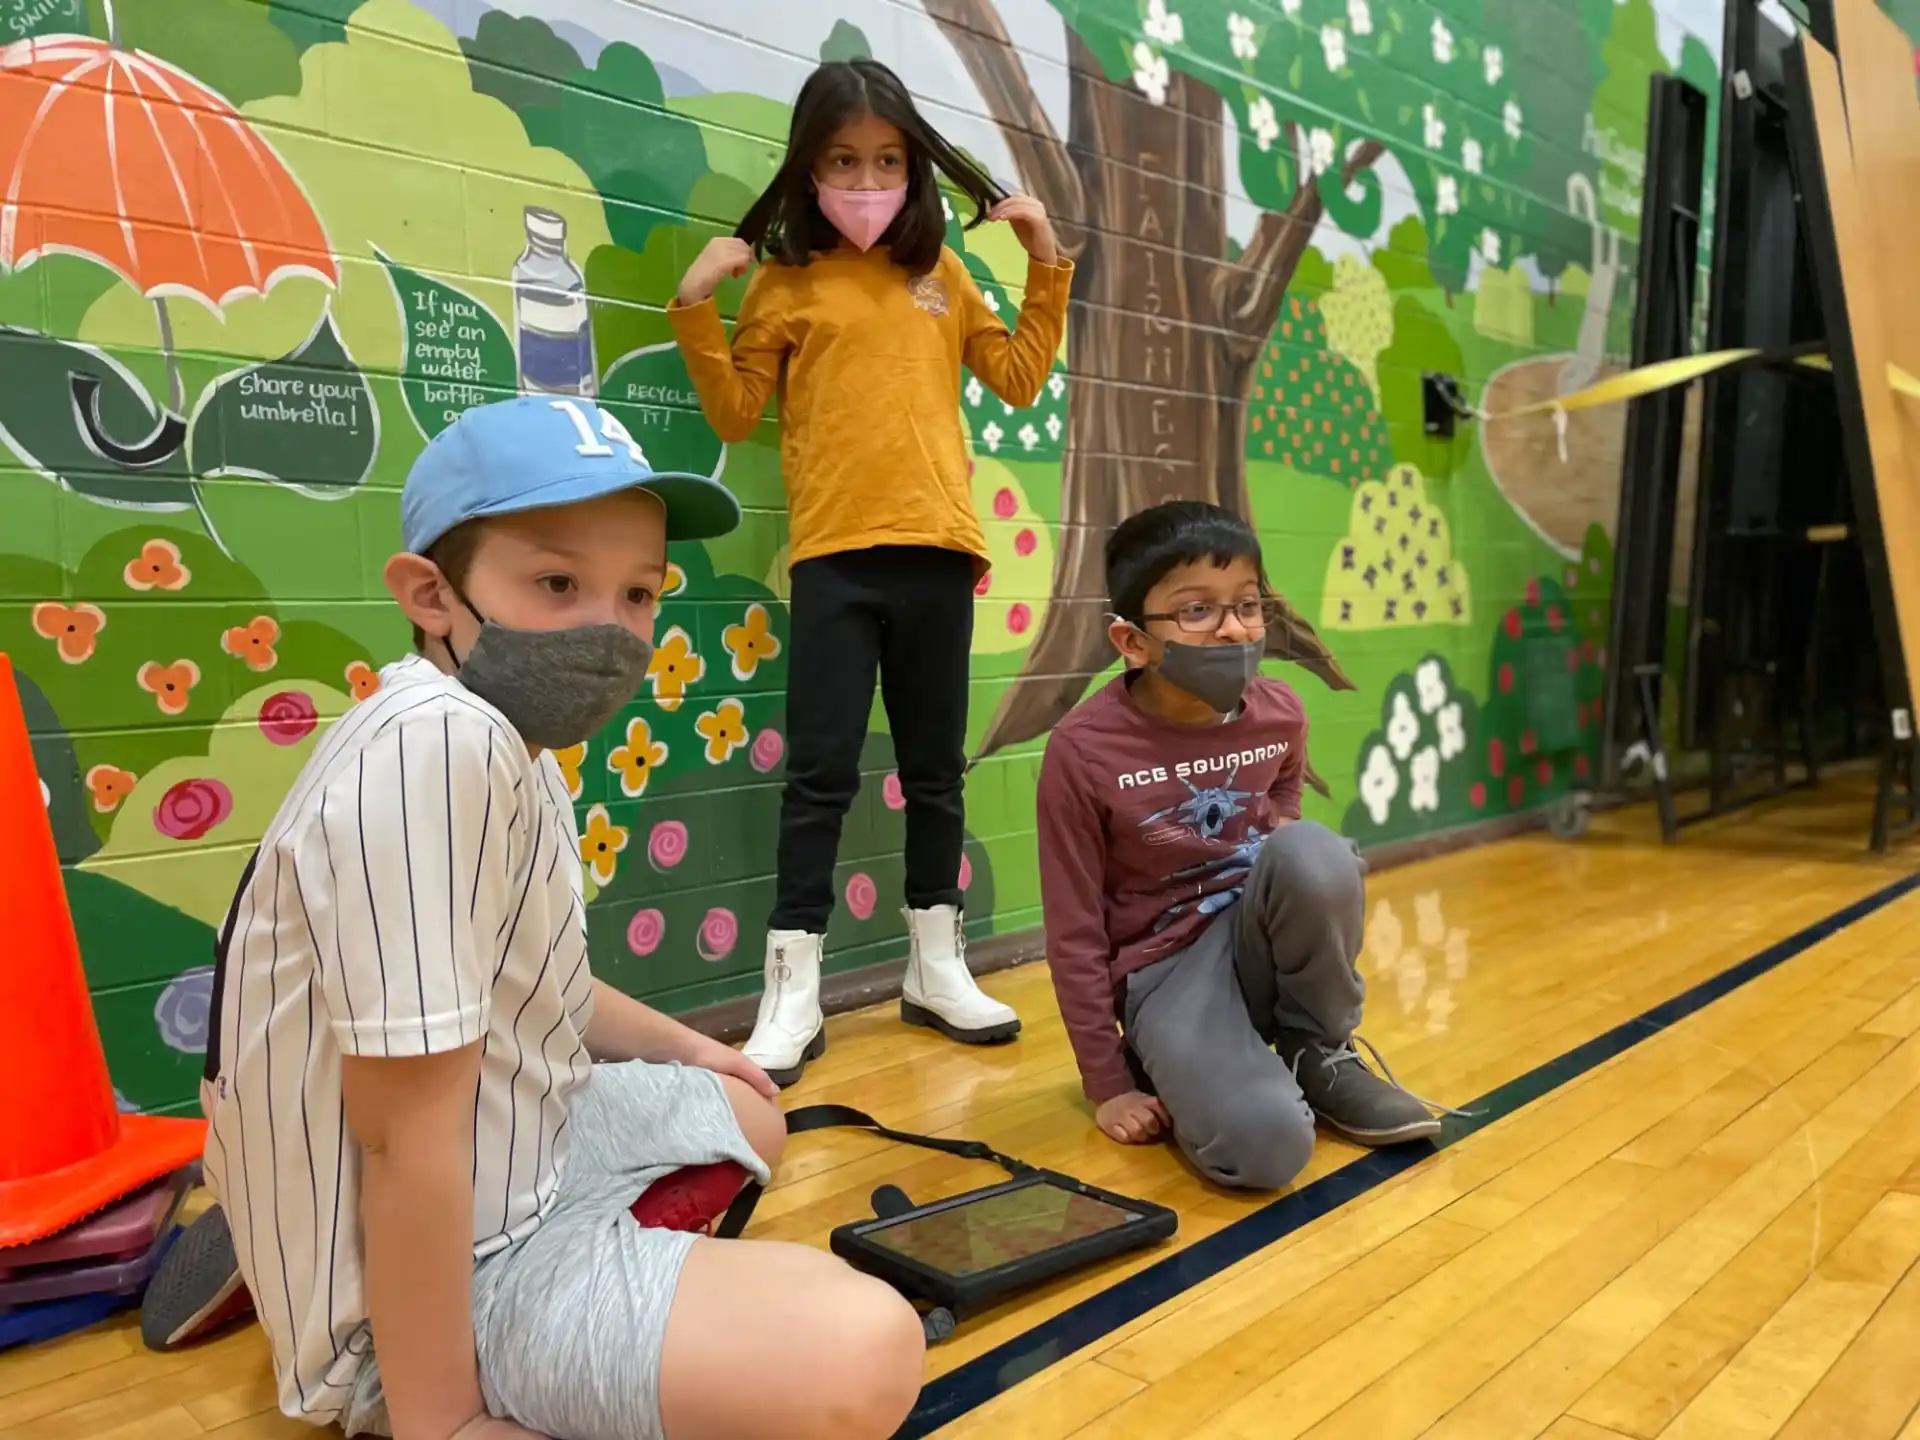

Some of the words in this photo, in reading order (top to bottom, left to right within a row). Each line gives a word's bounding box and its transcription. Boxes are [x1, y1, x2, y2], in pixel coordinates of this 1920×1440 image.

[412, 289, 438, 318] If
[442, 301, 480, 328] you
[414, 320, 450, 339] see
[457, 325, 486, 341] an
[1138, 151, 1184, 504] FAIRNES
[415, 343, 481, 370] empty
[421, 361, 488, 382] water
[239, 372, 304, 395] Share
[309, 384, 365, 409] your
[424, 381, 485, 406] bottle
[627, 383, 700, 405] RECYCLE
[240, 400, 359, 435] umbrella!
[640, 408, 670, 432] IT!
[1118, 767, 1169, 790] ACE
[1175, 741, 1289, 777] SQUADRON
